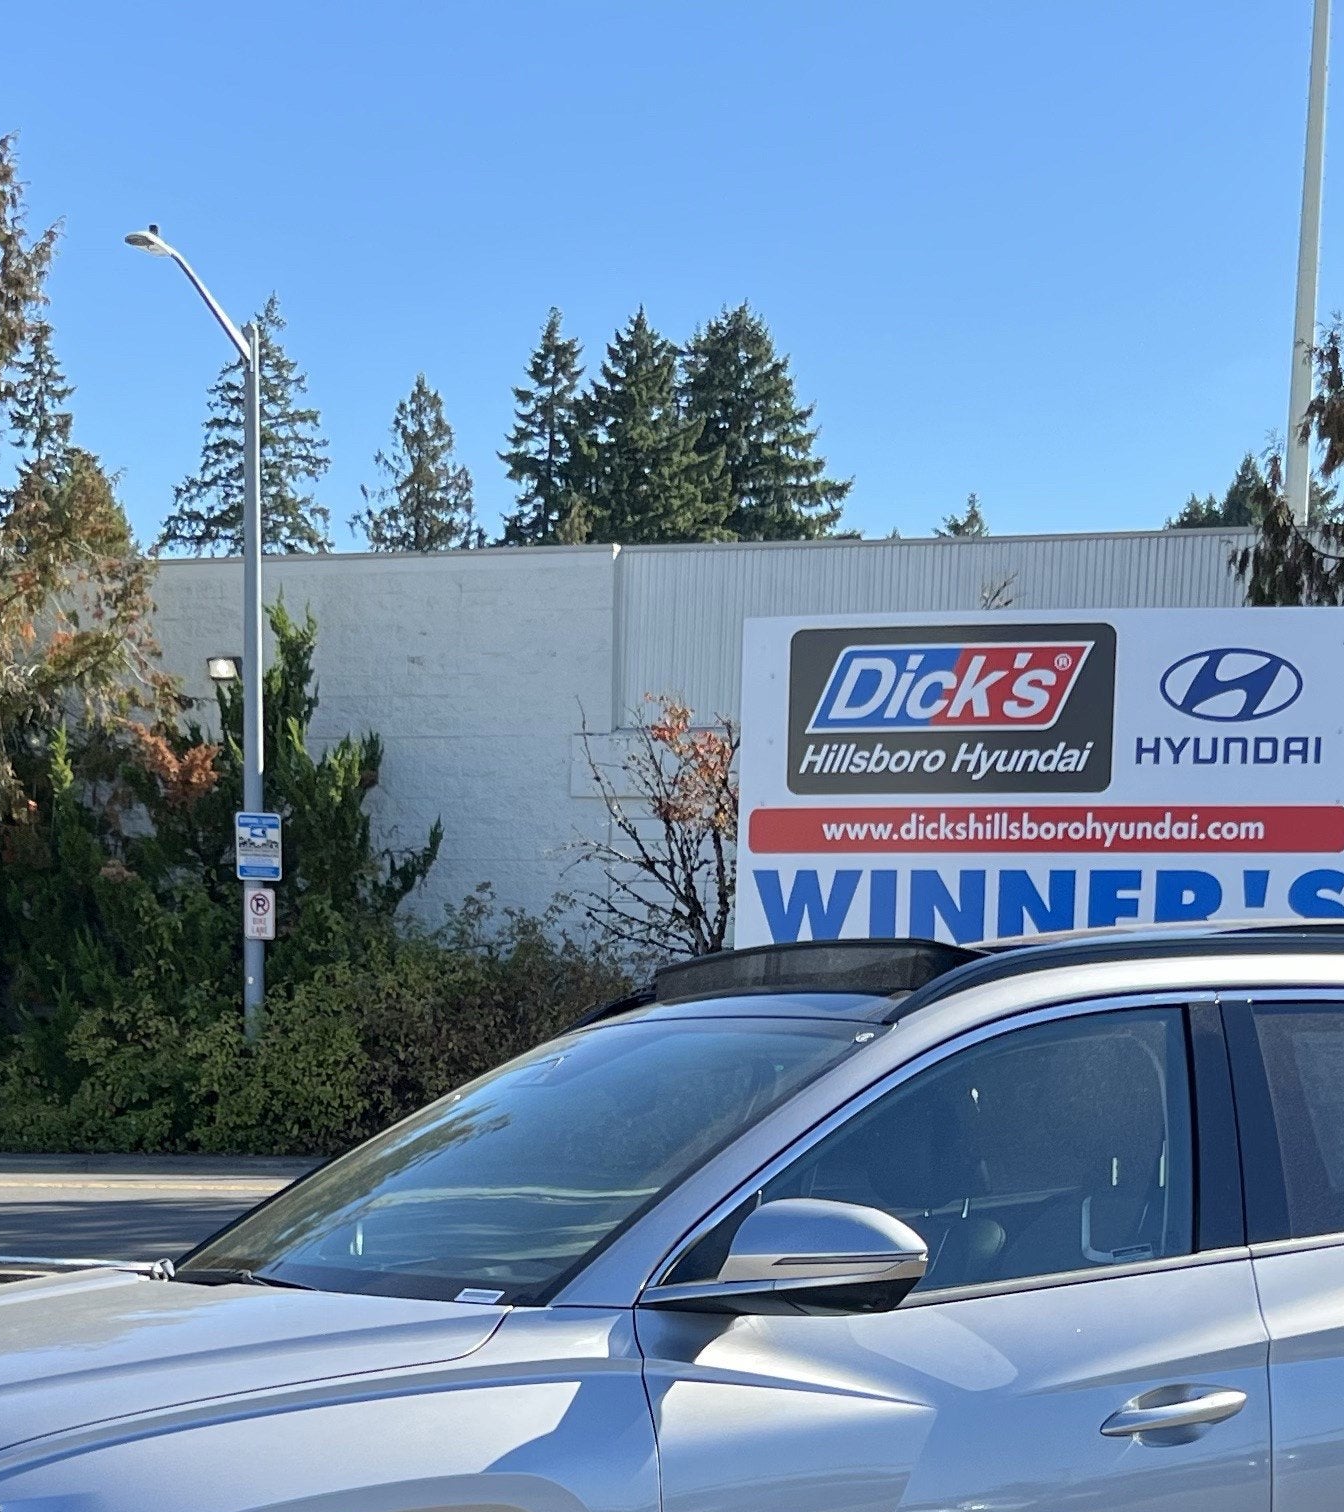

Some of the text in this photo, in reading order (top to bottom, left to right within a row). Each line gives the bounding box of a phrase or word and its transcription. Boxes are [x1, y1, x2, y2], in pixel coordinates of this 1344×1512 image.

[828, 652, 1056, 719] Dick's
[799, 742, 1095, 780] Hillsboro Hyundai
[1136, 737, 1322, 765] HYUNDAI
[822, 812, 1265, 848] www.dickshillsborohyundai.com
